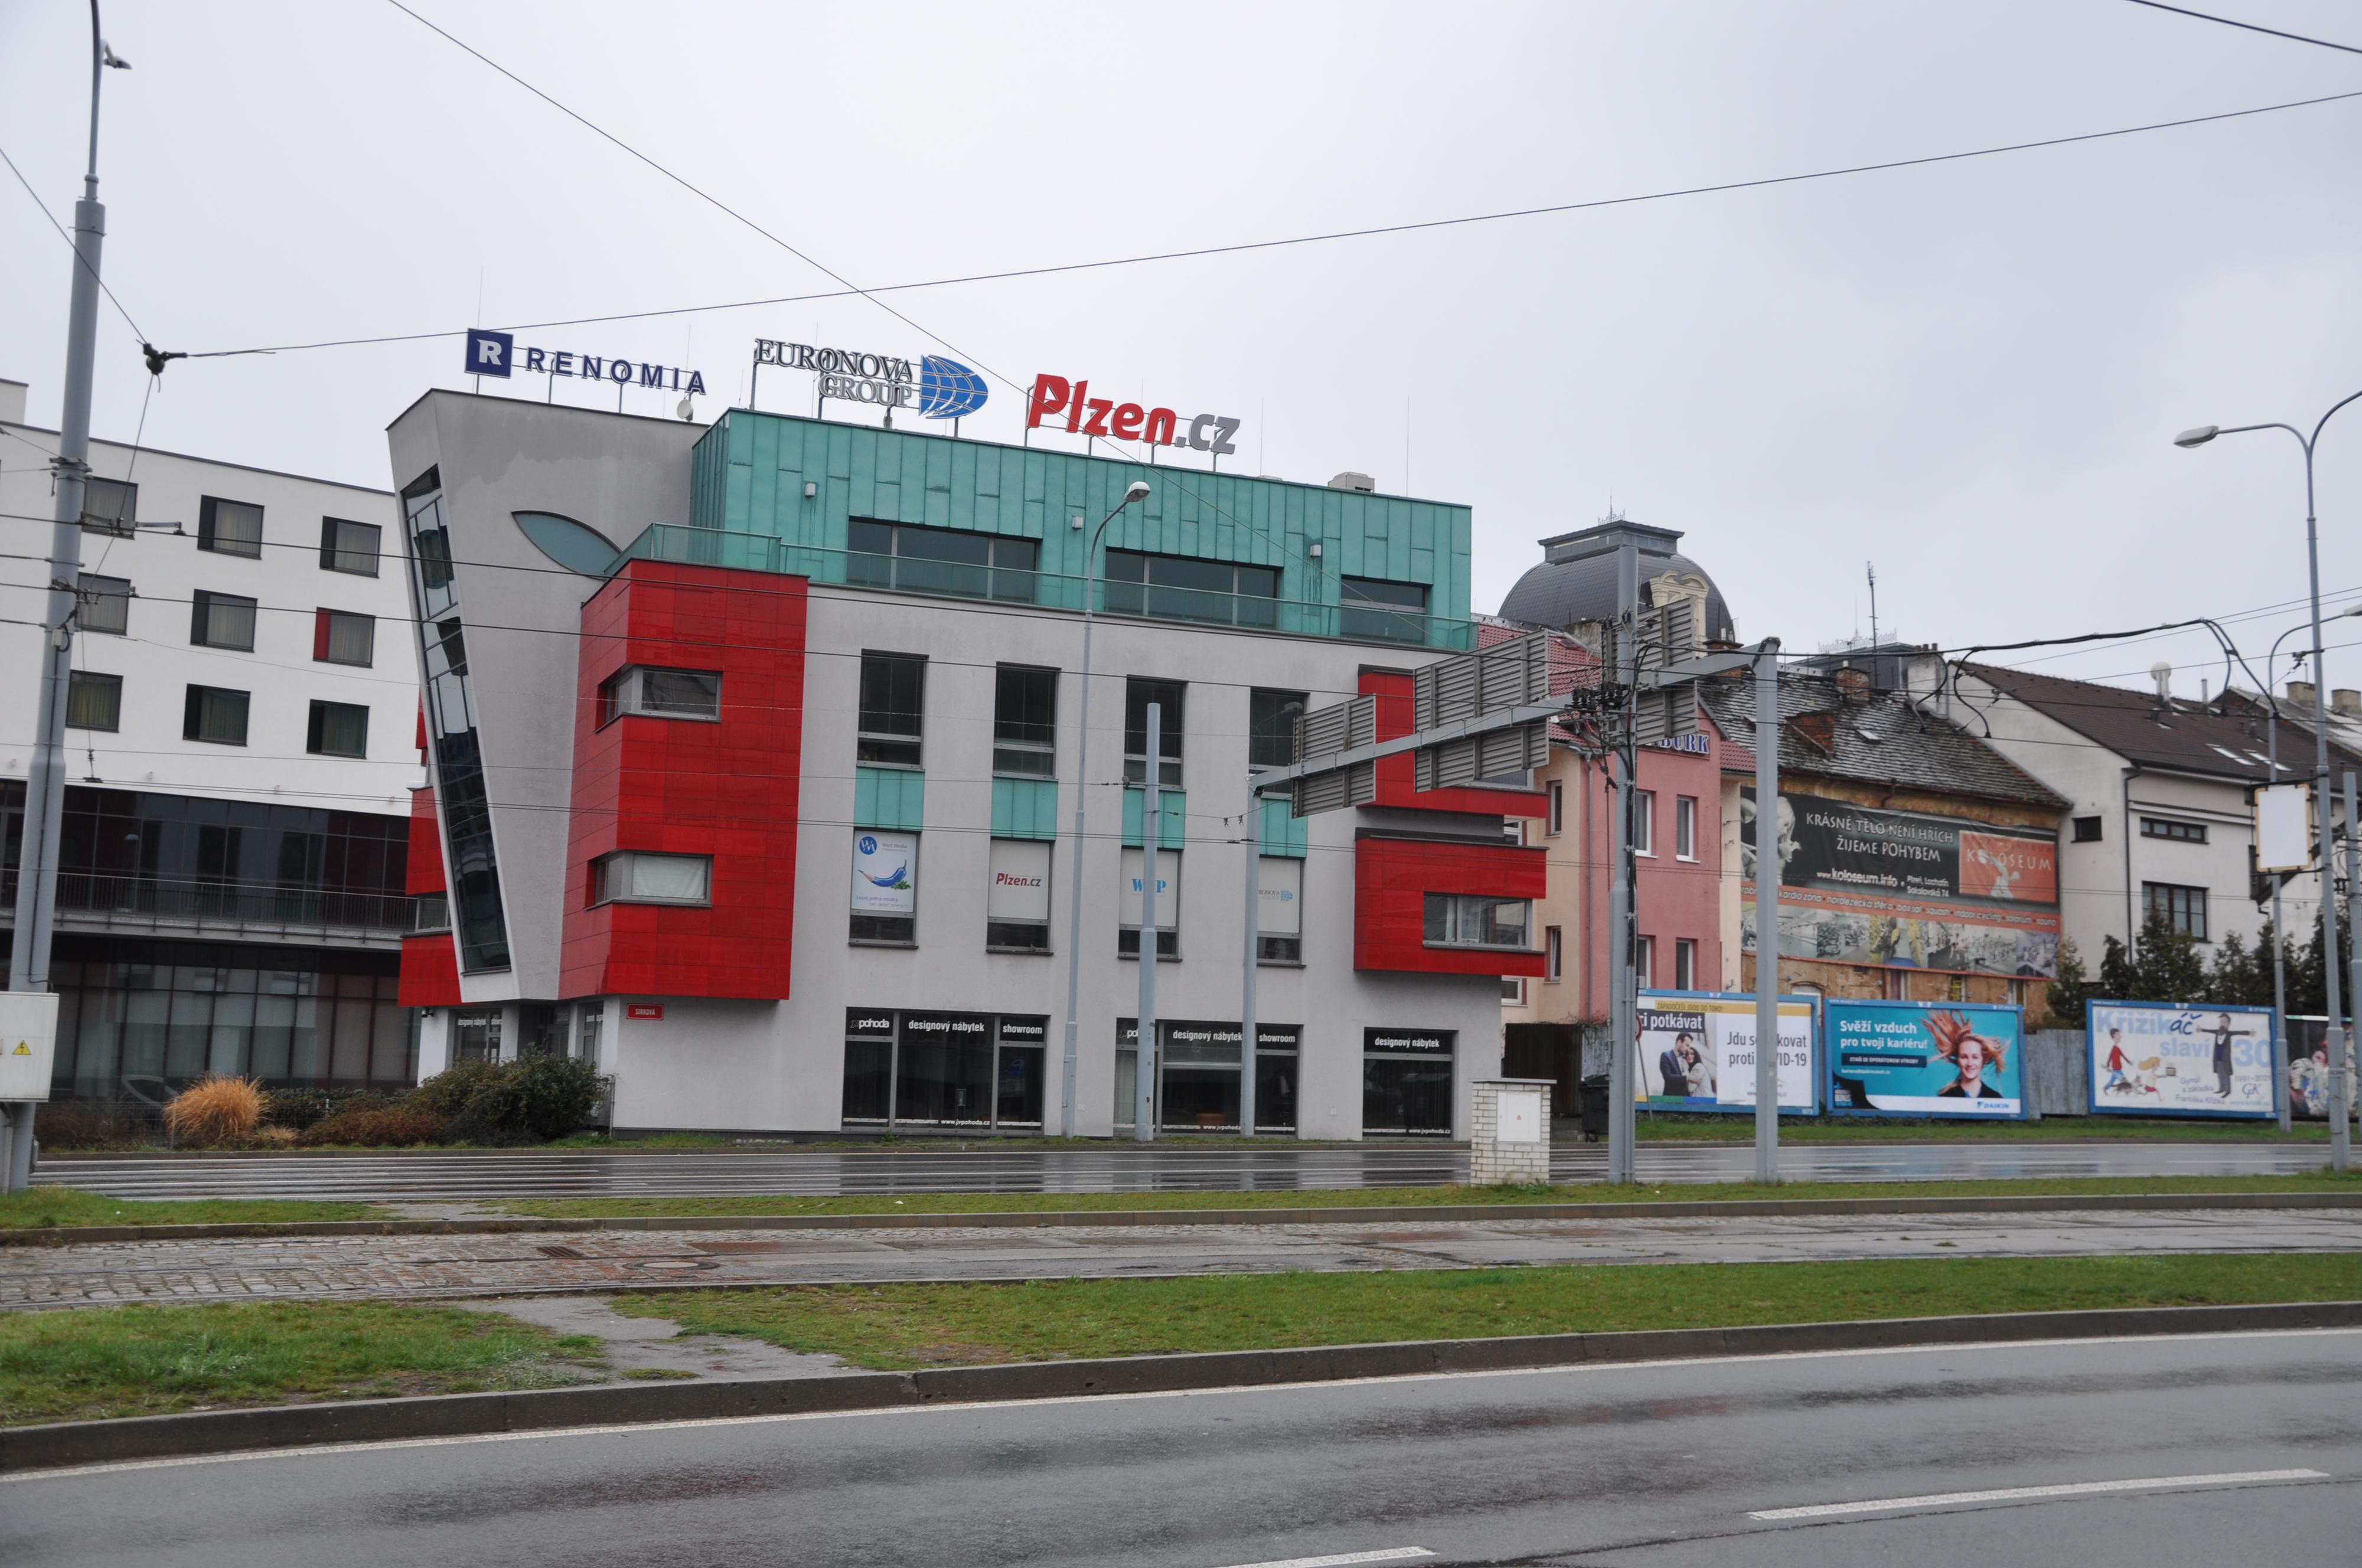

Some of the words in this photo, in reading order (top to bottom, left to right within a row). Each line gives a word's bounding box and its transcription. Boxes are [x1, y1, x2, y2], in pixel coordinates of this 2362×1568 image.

[754, 338, 912, 383] EURONOVA
[526, 347, 707, 395] RENOMIA
[818, 373, 912, 409] GROUP
[1026, 373, 1241, 454] Plzen.cz
[1806, 812, 1852, 831] KRÁSNÉ
[1855, 818, 1885, 835] TĚLO
[1889, 824, 1916, 838] NENÍ
[1919, 827, 1954, 843] HŘÍCH
[1837, 835, 1878, 854] ŽIJEME
[1882, 842, 1941, 862] POHYBEM
[1966, 848, 2051, 871] KLOSEUM
[996, 873, 1042, 887] Plzen.cz
[1816, 868, 1897, 887] www.koloseum.info
[908, 1020, 951, 1032] designový
[952, 1021, 985, 1033] nábytek
[1002, 1024, 1043, 1034] showroom
[1650, 1012, 1702, 1030] potkávat
[1840, 1020, 1871, 1033] Svěží
[1874, 1022, 1917, 1034] vzduch
[1173, 1030, 1211, 1042] designový
[1213, 1031, 1243, 1043] nábytek
[1258, 1033, 1296, 1043] showroom
[1374, 1037, 1411, 1048] designový
[1412, 1038, 1440, 1049] nábytek
[1727, 1031, 1746, 1046] Jdu
[1777, 1034, 1807, 1047] kovat
[1841, 1038, 1858, 1049] pro
[1861, 1038, 1885, 1050] tvoji
[1887, 1039, 1928, 1049] kariéru!
[2159, 1037, 2210, 1057] slaví
[2233, 1038, 2270, 1067] 30
[1729, 1052, 1754, 1067] proti
